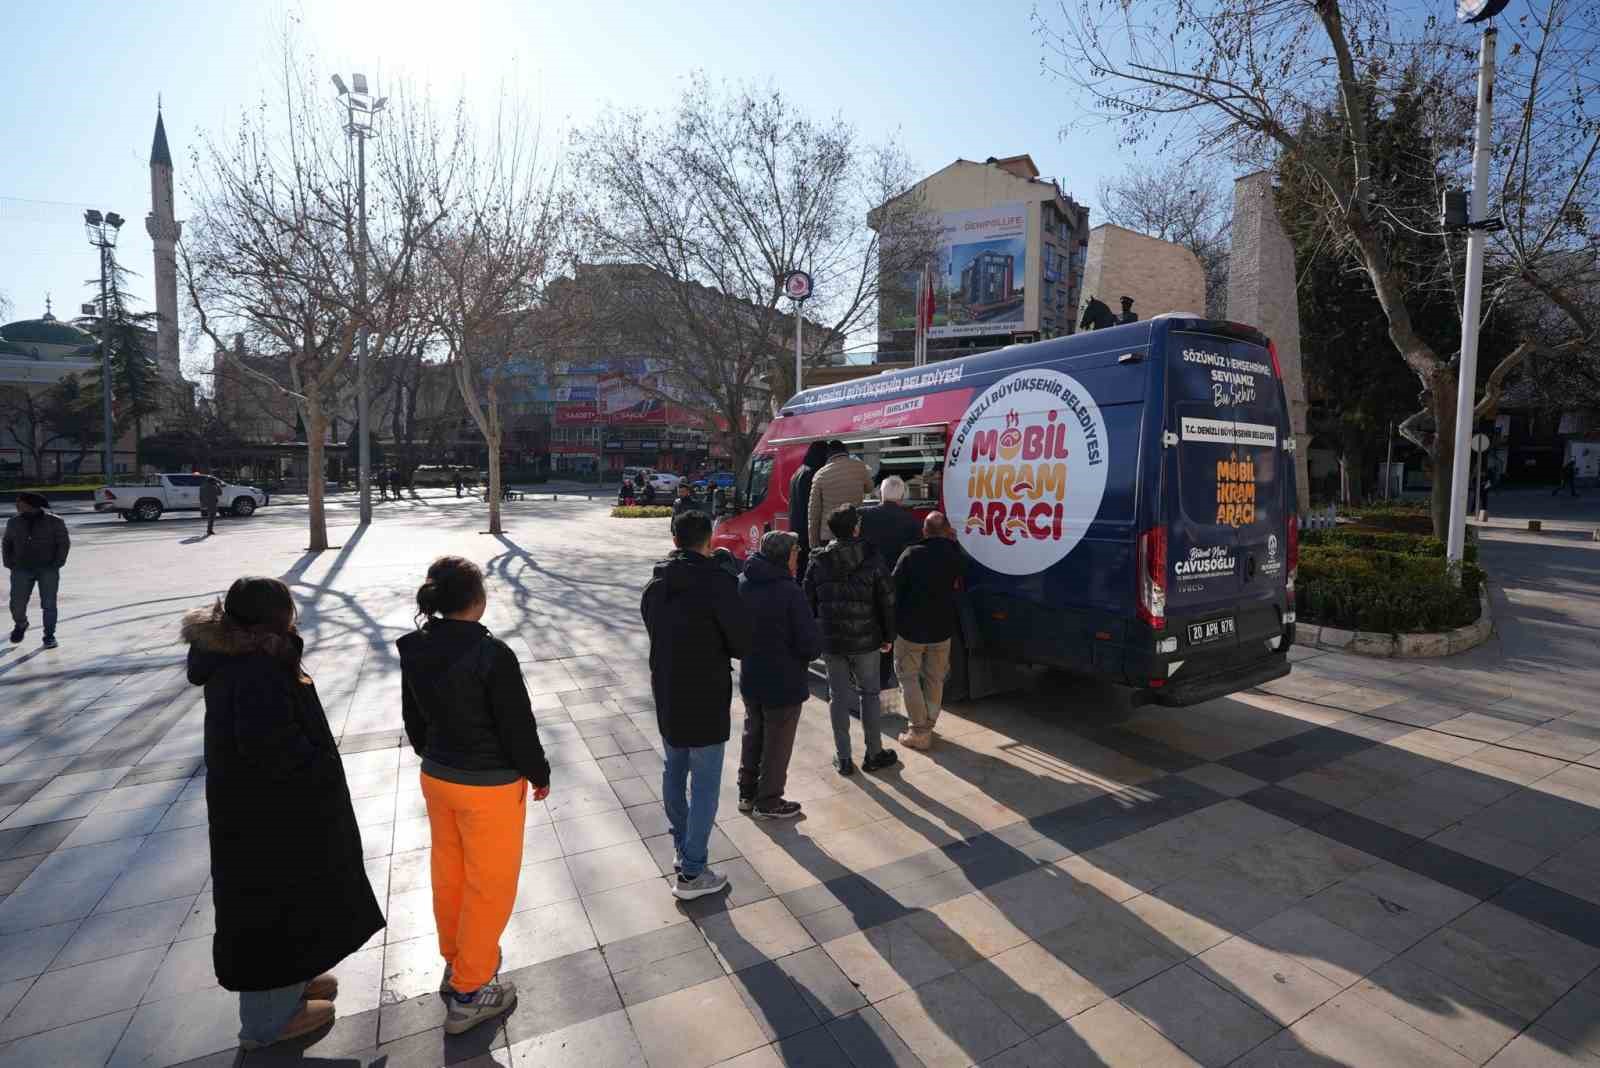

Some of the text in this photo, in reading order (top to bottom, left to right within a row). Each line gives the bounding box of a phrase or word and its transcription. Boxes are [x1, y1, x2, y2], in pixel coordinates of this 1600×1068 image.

[1183, 348, 1226, 367] SÖZÜMÜZ
[901, 363, 964, 390] BELEDİYESİ
[1212, 383, 1231, 408] Bu
[949, 377, 1103, 467] T.C. DENİZLİ BÜYÜKŞEHİR BELEDİYESİ
[1185, 424, 1197, 434] T.C.
[971, 409, 1069, 463] MOBİL
[965, 501, 1064, 546] ARACI
[1216, 503, 1255, 528] ARACI
[1192, 625, 1204, 640] 20
